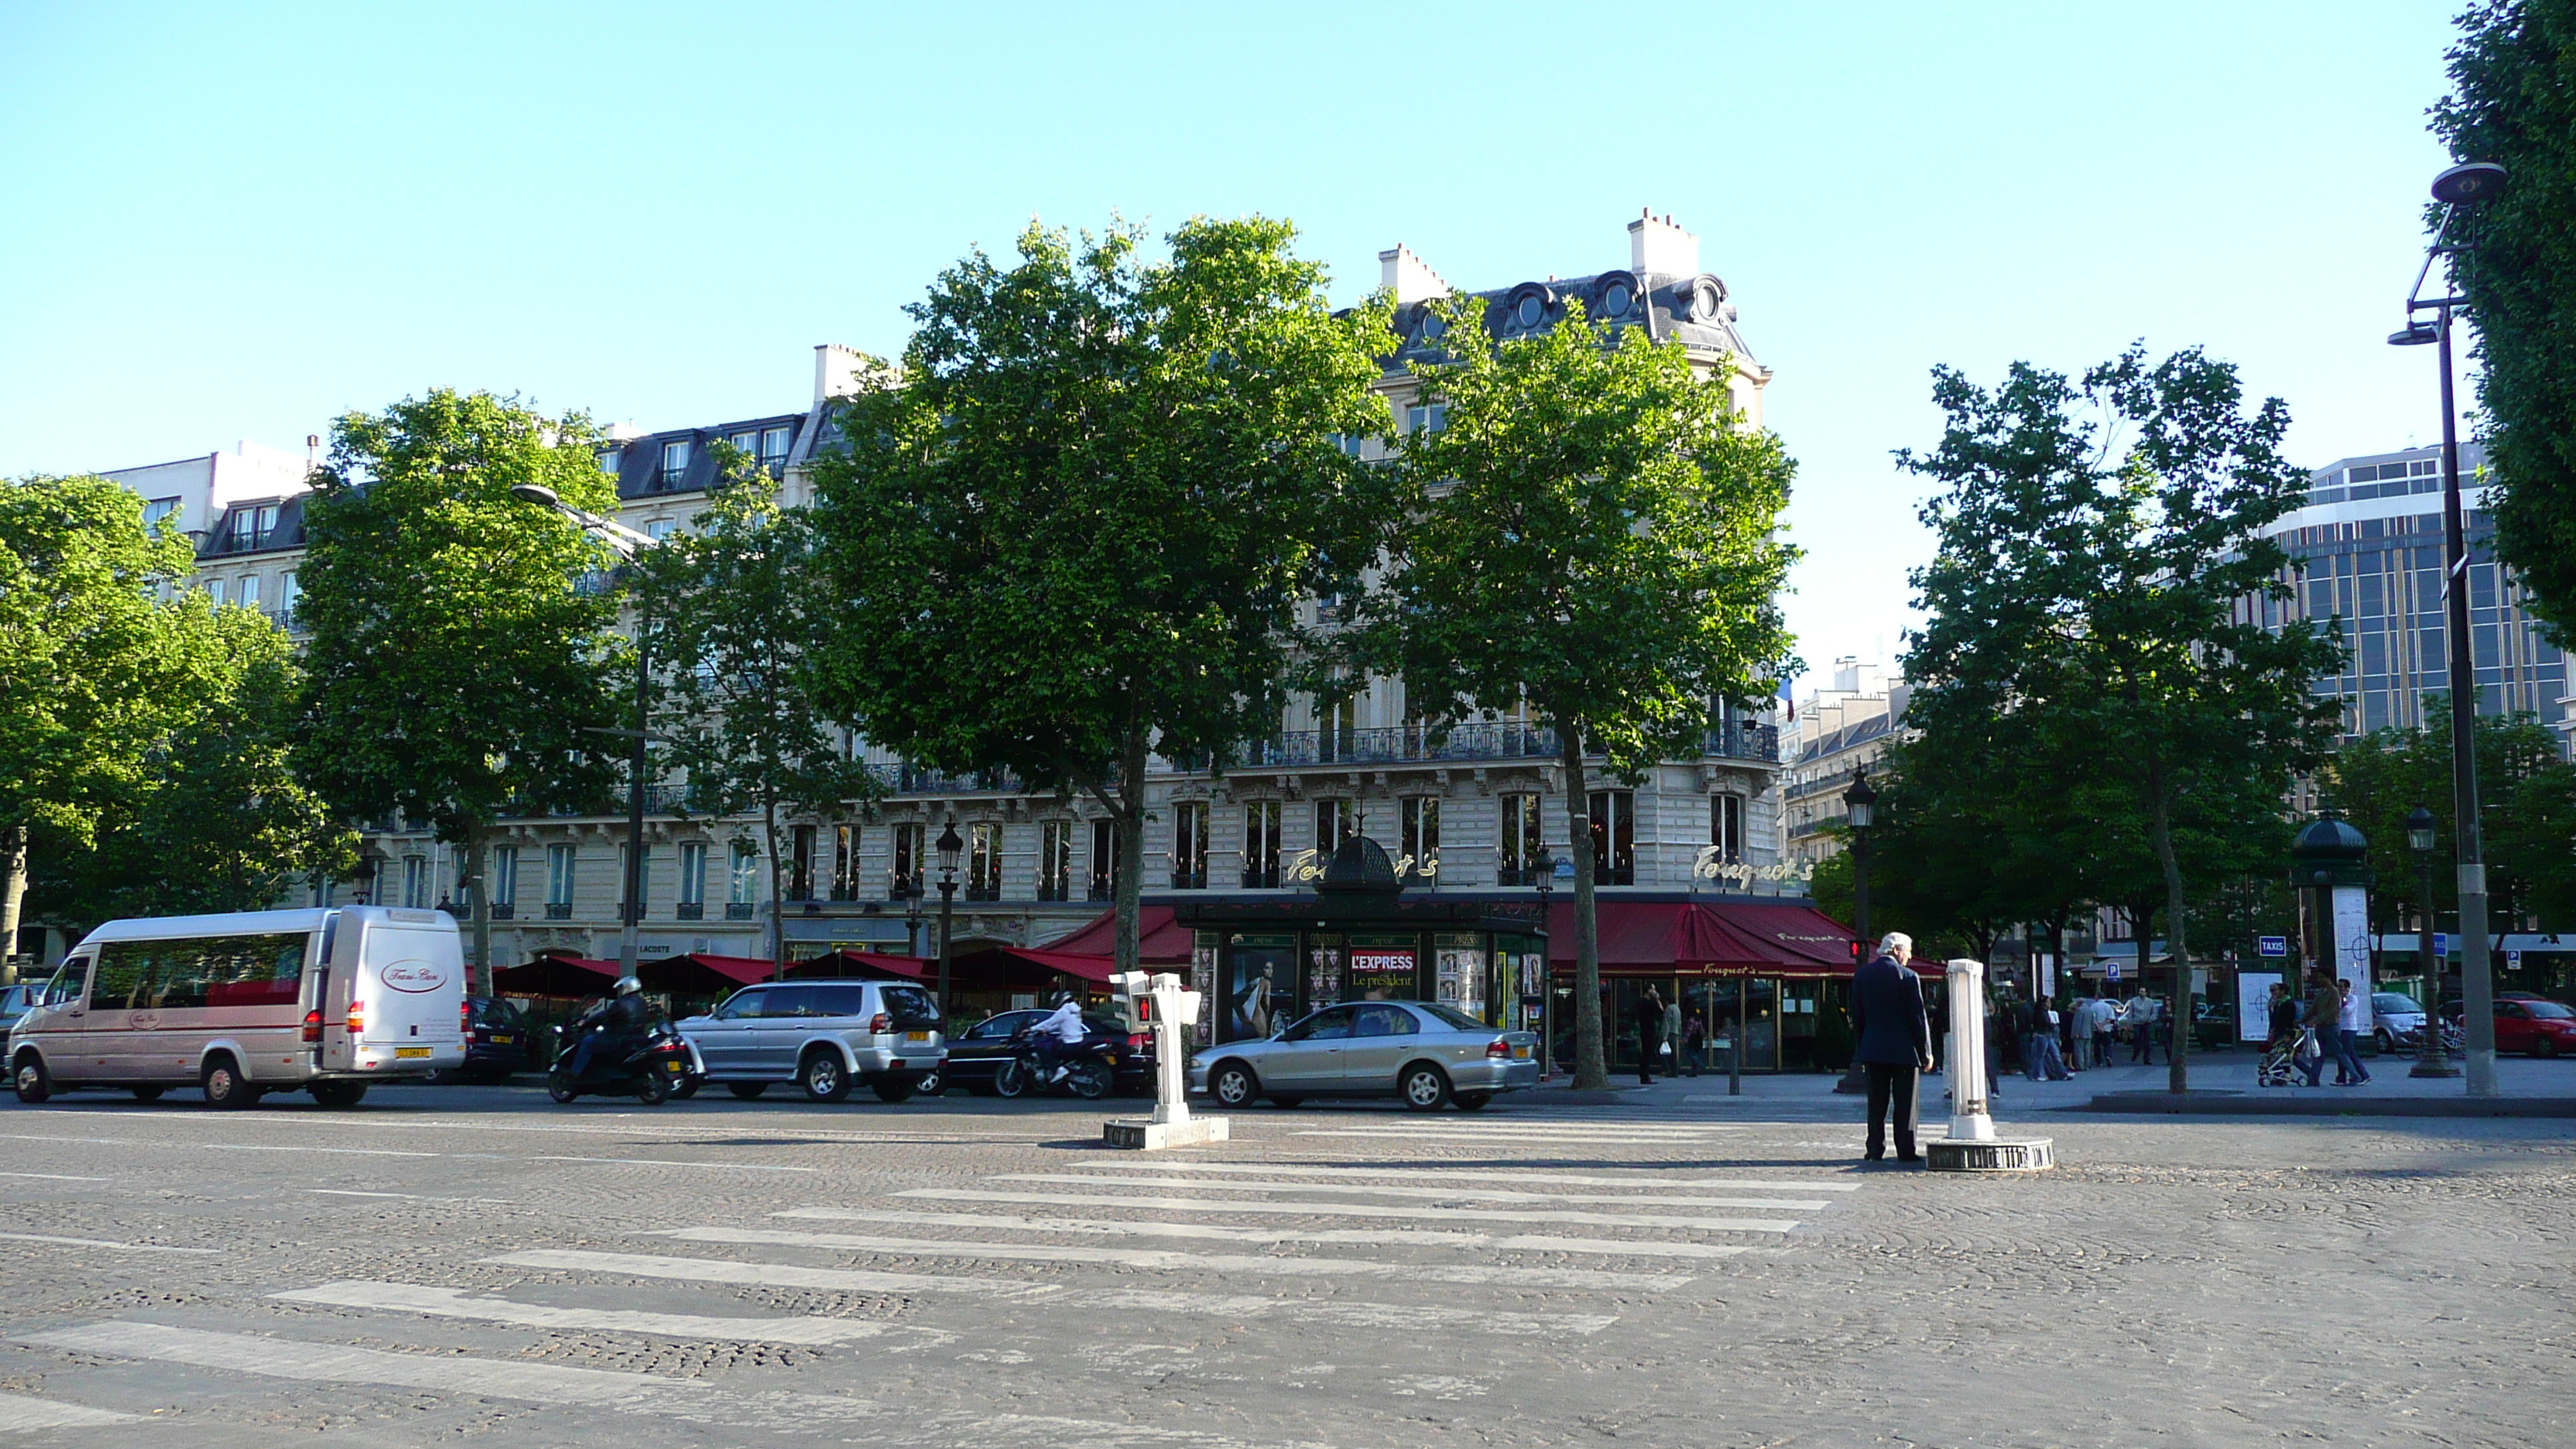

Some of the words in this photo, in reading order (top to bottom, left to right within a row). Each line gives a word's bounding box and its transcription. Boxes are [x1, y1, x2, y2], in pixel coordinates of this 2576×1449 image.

[1694, 845, 1814, 890] Fouquet's
[2262, 942, 2283, 951] TAXIS
[1351, 955, 1413, 969] L'EXPRESS
[1702, 963, 1757, 978] Fouquet's
[2110, 966, 2116, 975] P
[1353, 974, 1365, 985] Le
